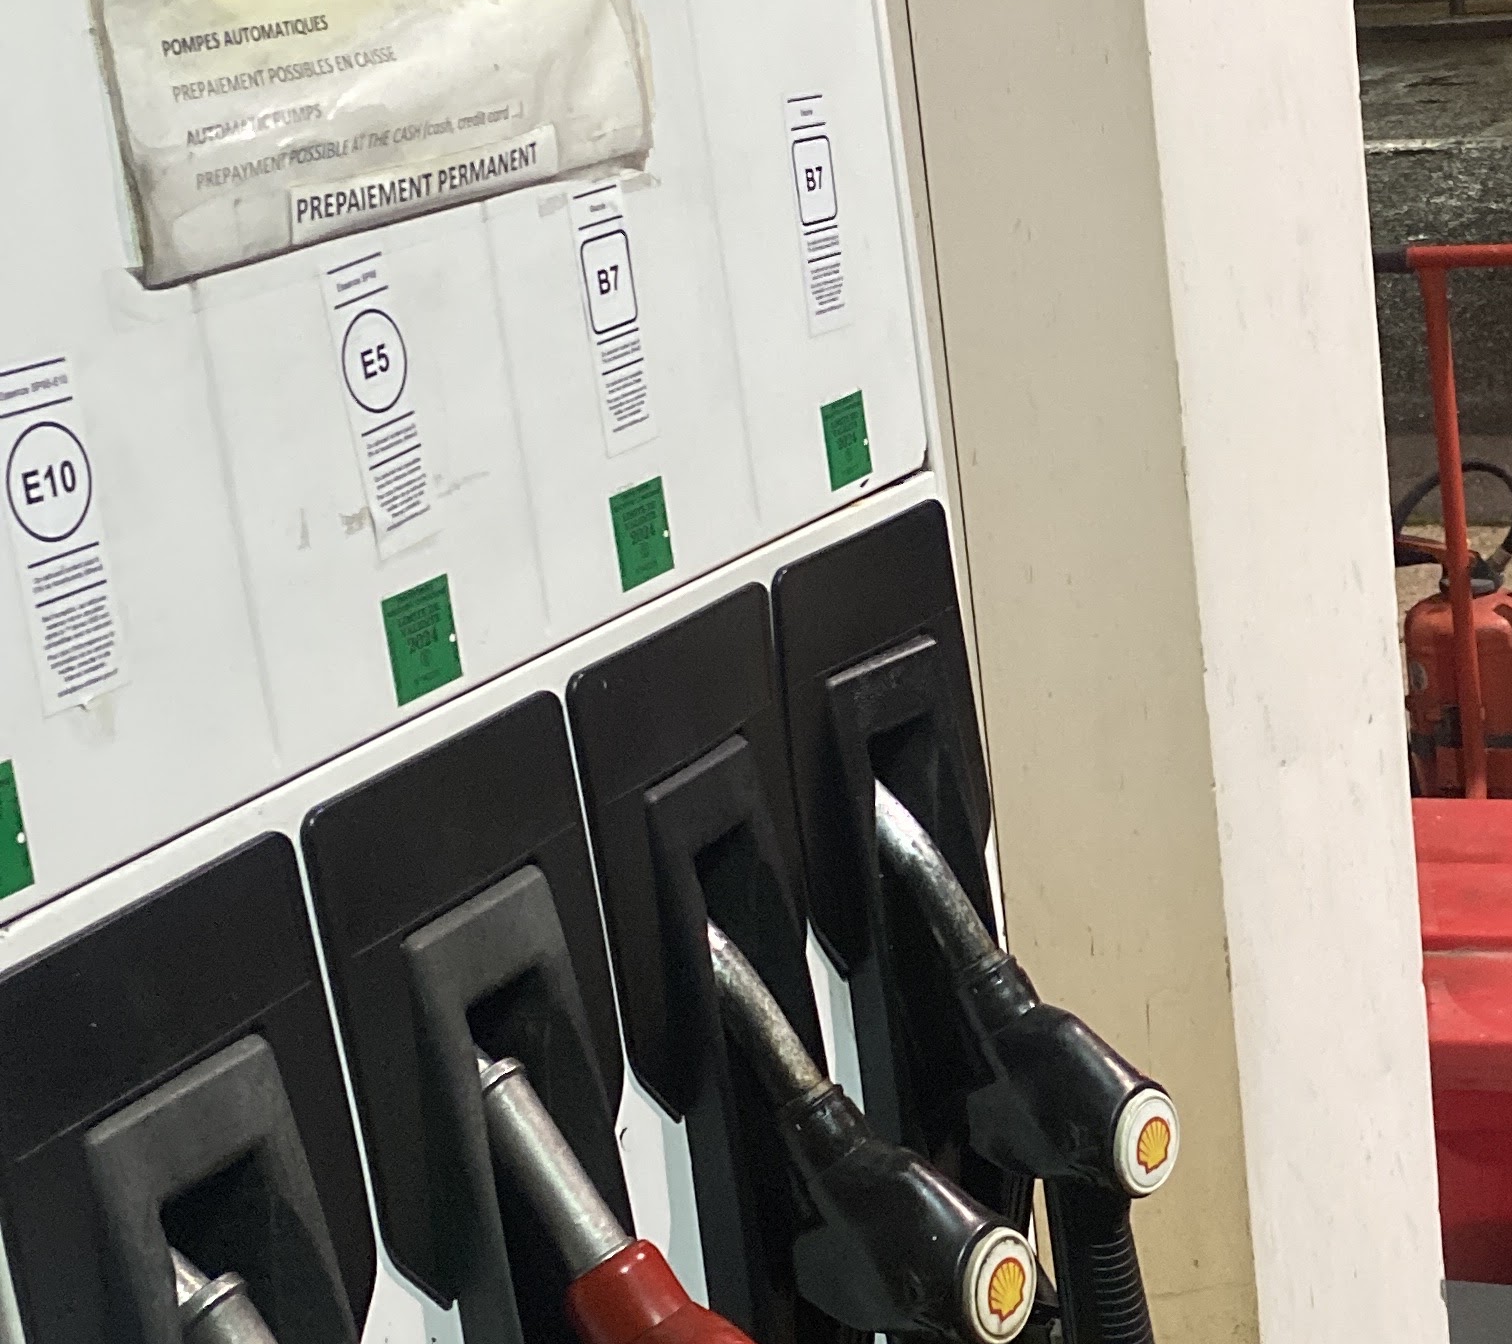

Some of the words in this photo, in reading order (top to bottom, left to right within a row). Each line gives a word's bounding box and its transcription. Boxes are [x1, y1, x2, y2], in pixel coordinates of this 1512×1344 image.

[161, 32, 220, 56] POMPES
[224, 14, 329, 47] AUTOMATIQUES
[172, 68, 266, 103] PREPAIEMENT
[268, 58, 334, 86] POSSIBLES
[335, 53, 354, 72] EN
[354, 45, 398, 68] CAISSE
[196, 152, 287, 190] PREPAYMENT
[288, 138, 350, 164] POSSIBLE
[351, 132, 366, 154] AT
[367, 129, 391, 149] THE
[392, 123, 421, 144] CASH
[295, 171, 433, 224] PREPAIEMENT
[437, 141, 537, 194] PERMANENT
[804, 166, 824, 193] B7
[597, 264, 619, 296] B7
[360, 343, 390, 380] E5
[21, 460, 76, 505] E10
